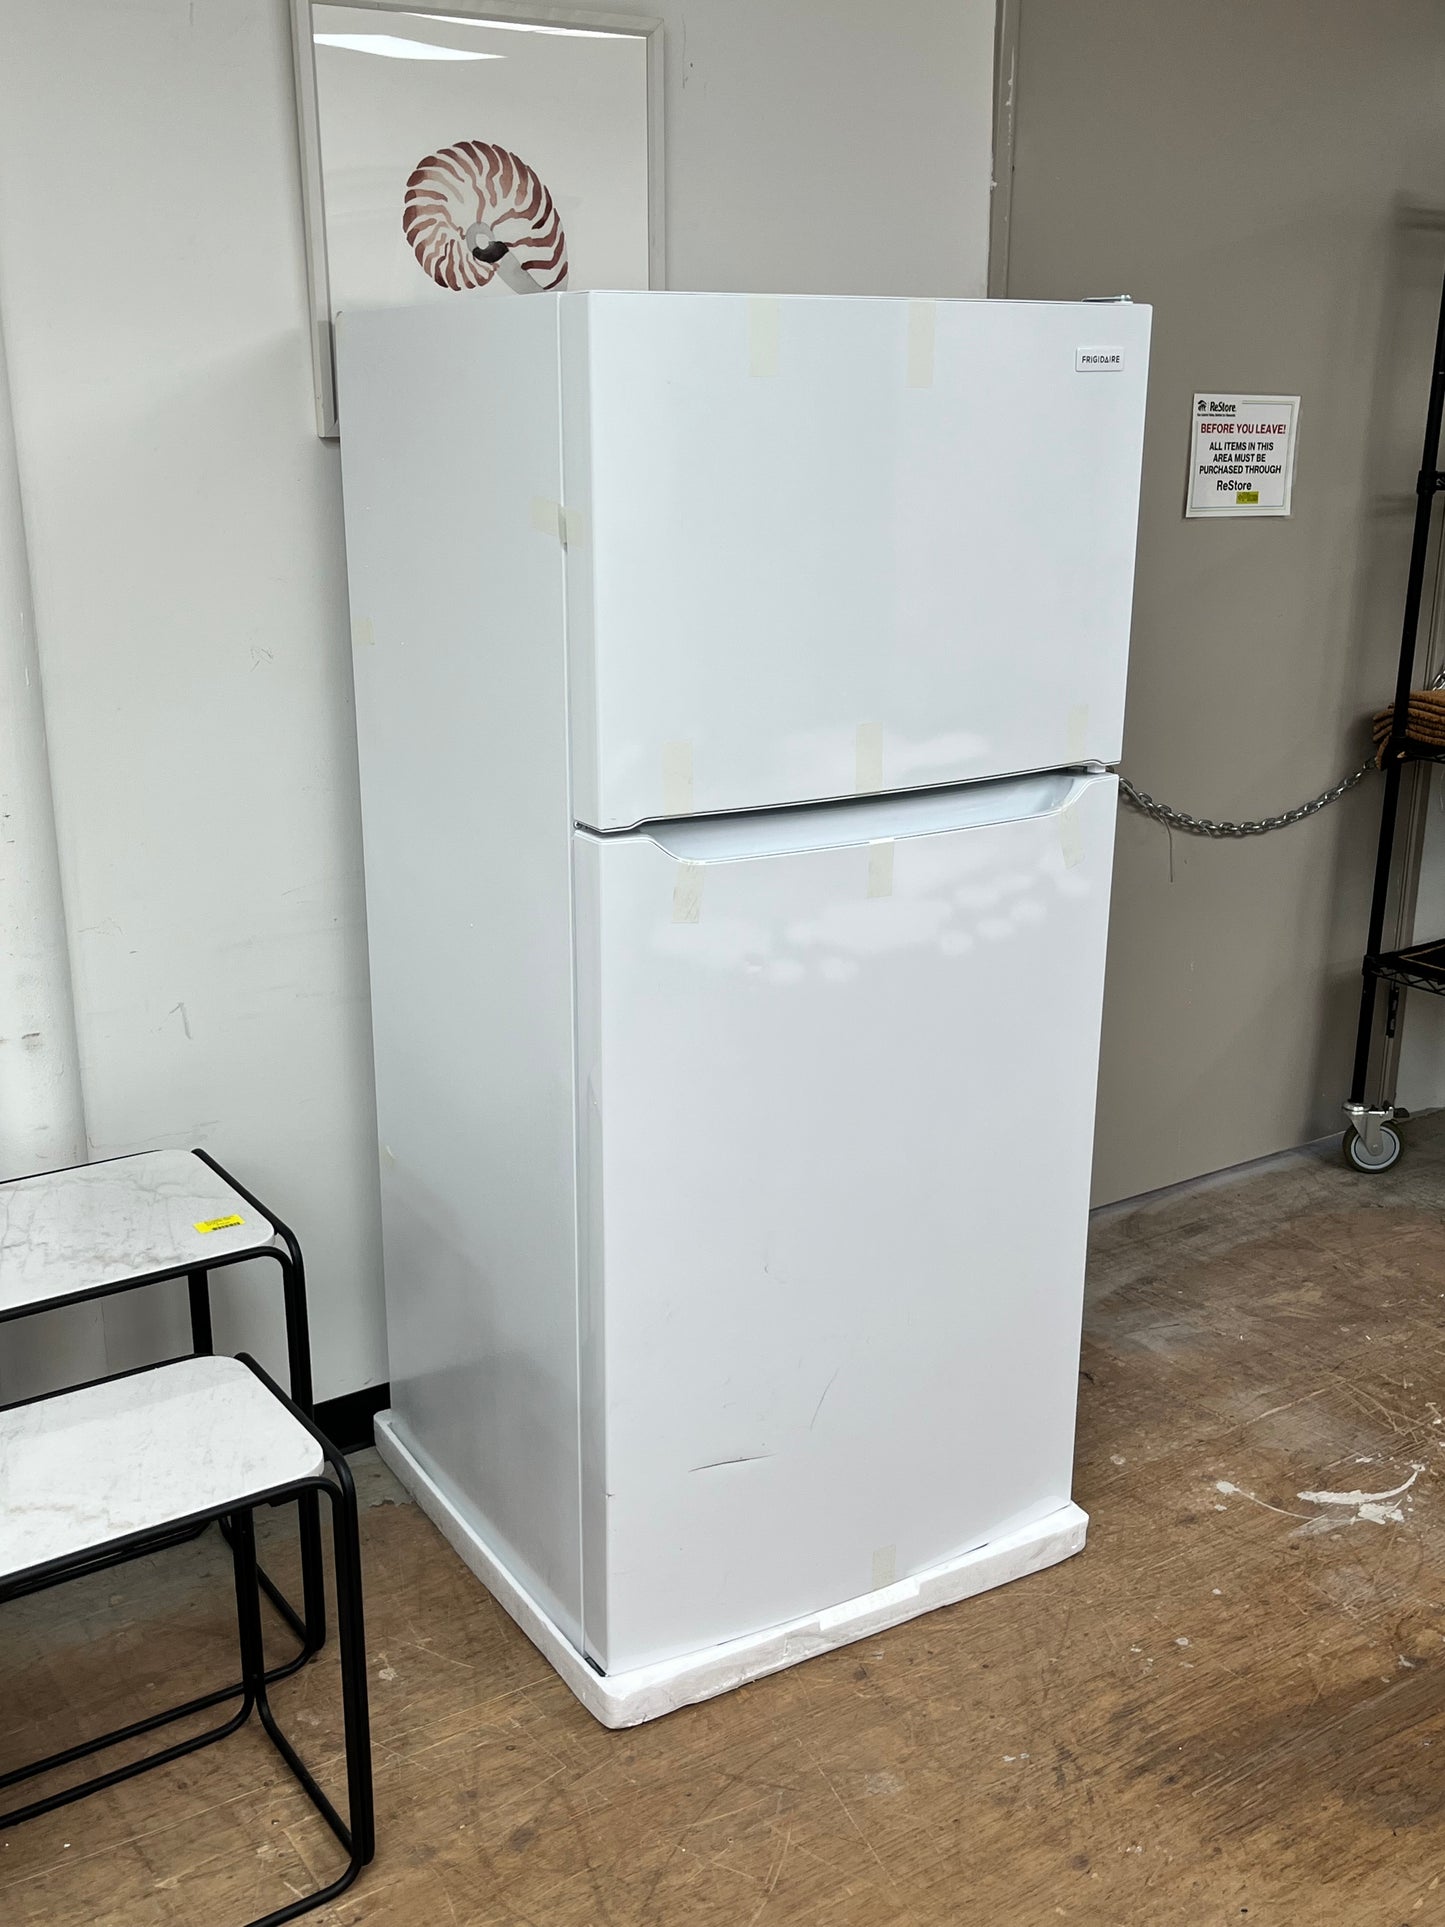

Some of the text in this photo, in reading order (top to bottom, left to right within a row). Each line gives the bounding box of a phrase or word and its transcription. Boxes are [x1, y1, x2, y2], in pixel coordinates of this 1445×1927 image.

[1081, 355, 1120, 364] FRIGIDAIRE
[1210, 401, 1236, 413] ReStore
[1200, 423, 1286, 435] BEFORE YOU LEAVE!
[1209, 442, 1274, 451] ALL ITEMS IN THIS
[1213, 453, 1266, 463] AREA MUST BE
[1199, 465, 1282, 474] PURCHASED THROUGH
[1216, 480, 1252, 491] ReStore
